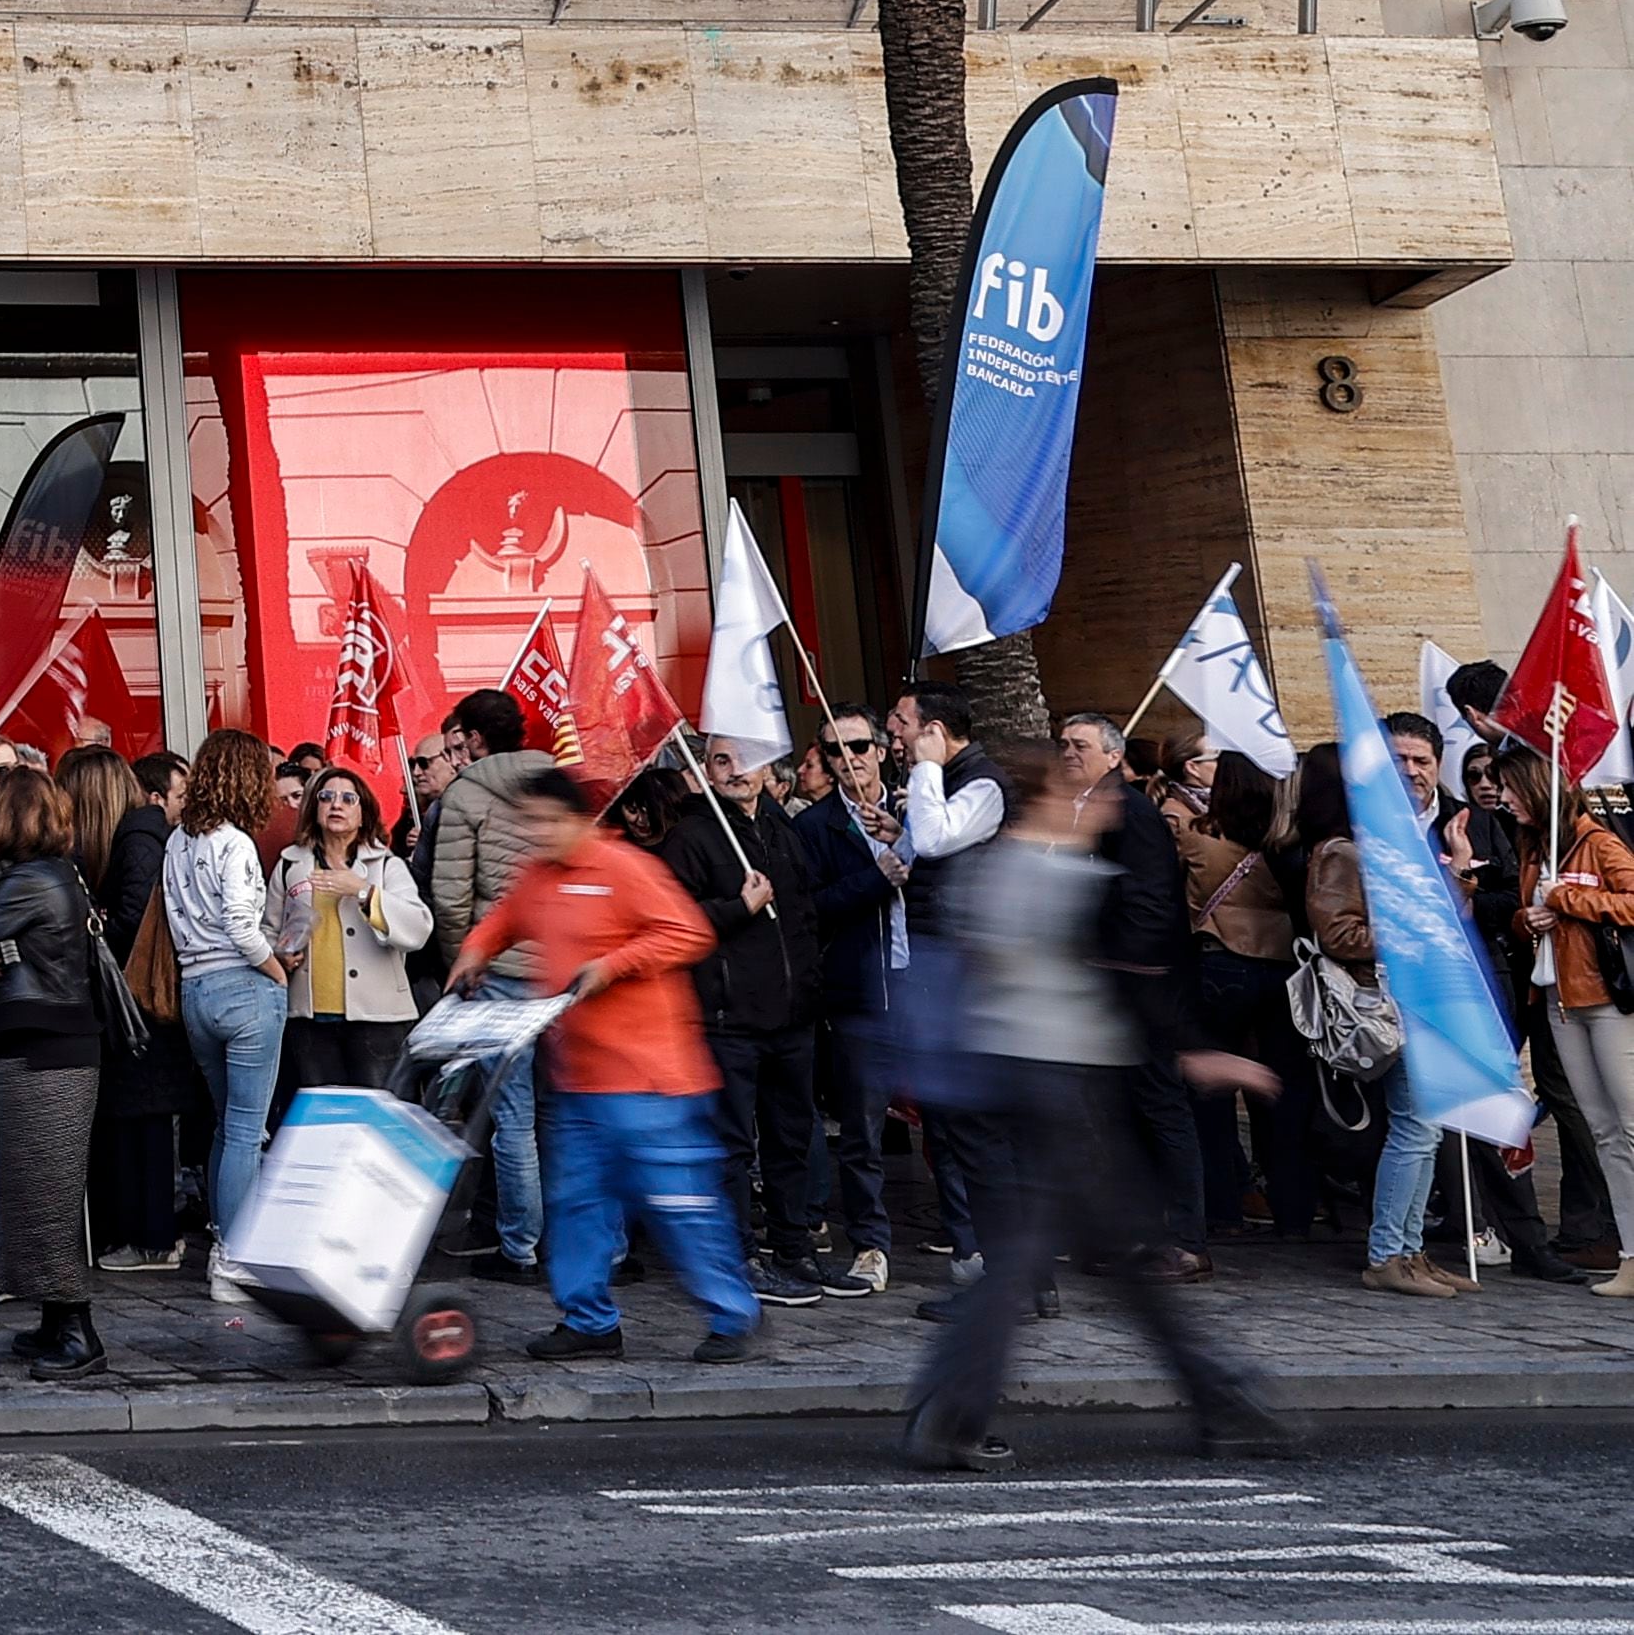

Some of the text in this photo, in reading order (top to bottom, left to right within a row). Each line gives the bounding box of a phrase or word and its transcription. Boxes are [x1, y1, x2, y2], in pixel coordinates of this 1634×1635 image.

[972, 252, 1065, 342] fib
[966, 347, 1079, 387] INDEPENDIENTE
[967, 332, 1056, 368] FEDERACIÓN
[965, 362, 1036, 398] BANCARIA
[1317, 355, 1363, 414] 8
[513, 674, 562, 730] país vale
